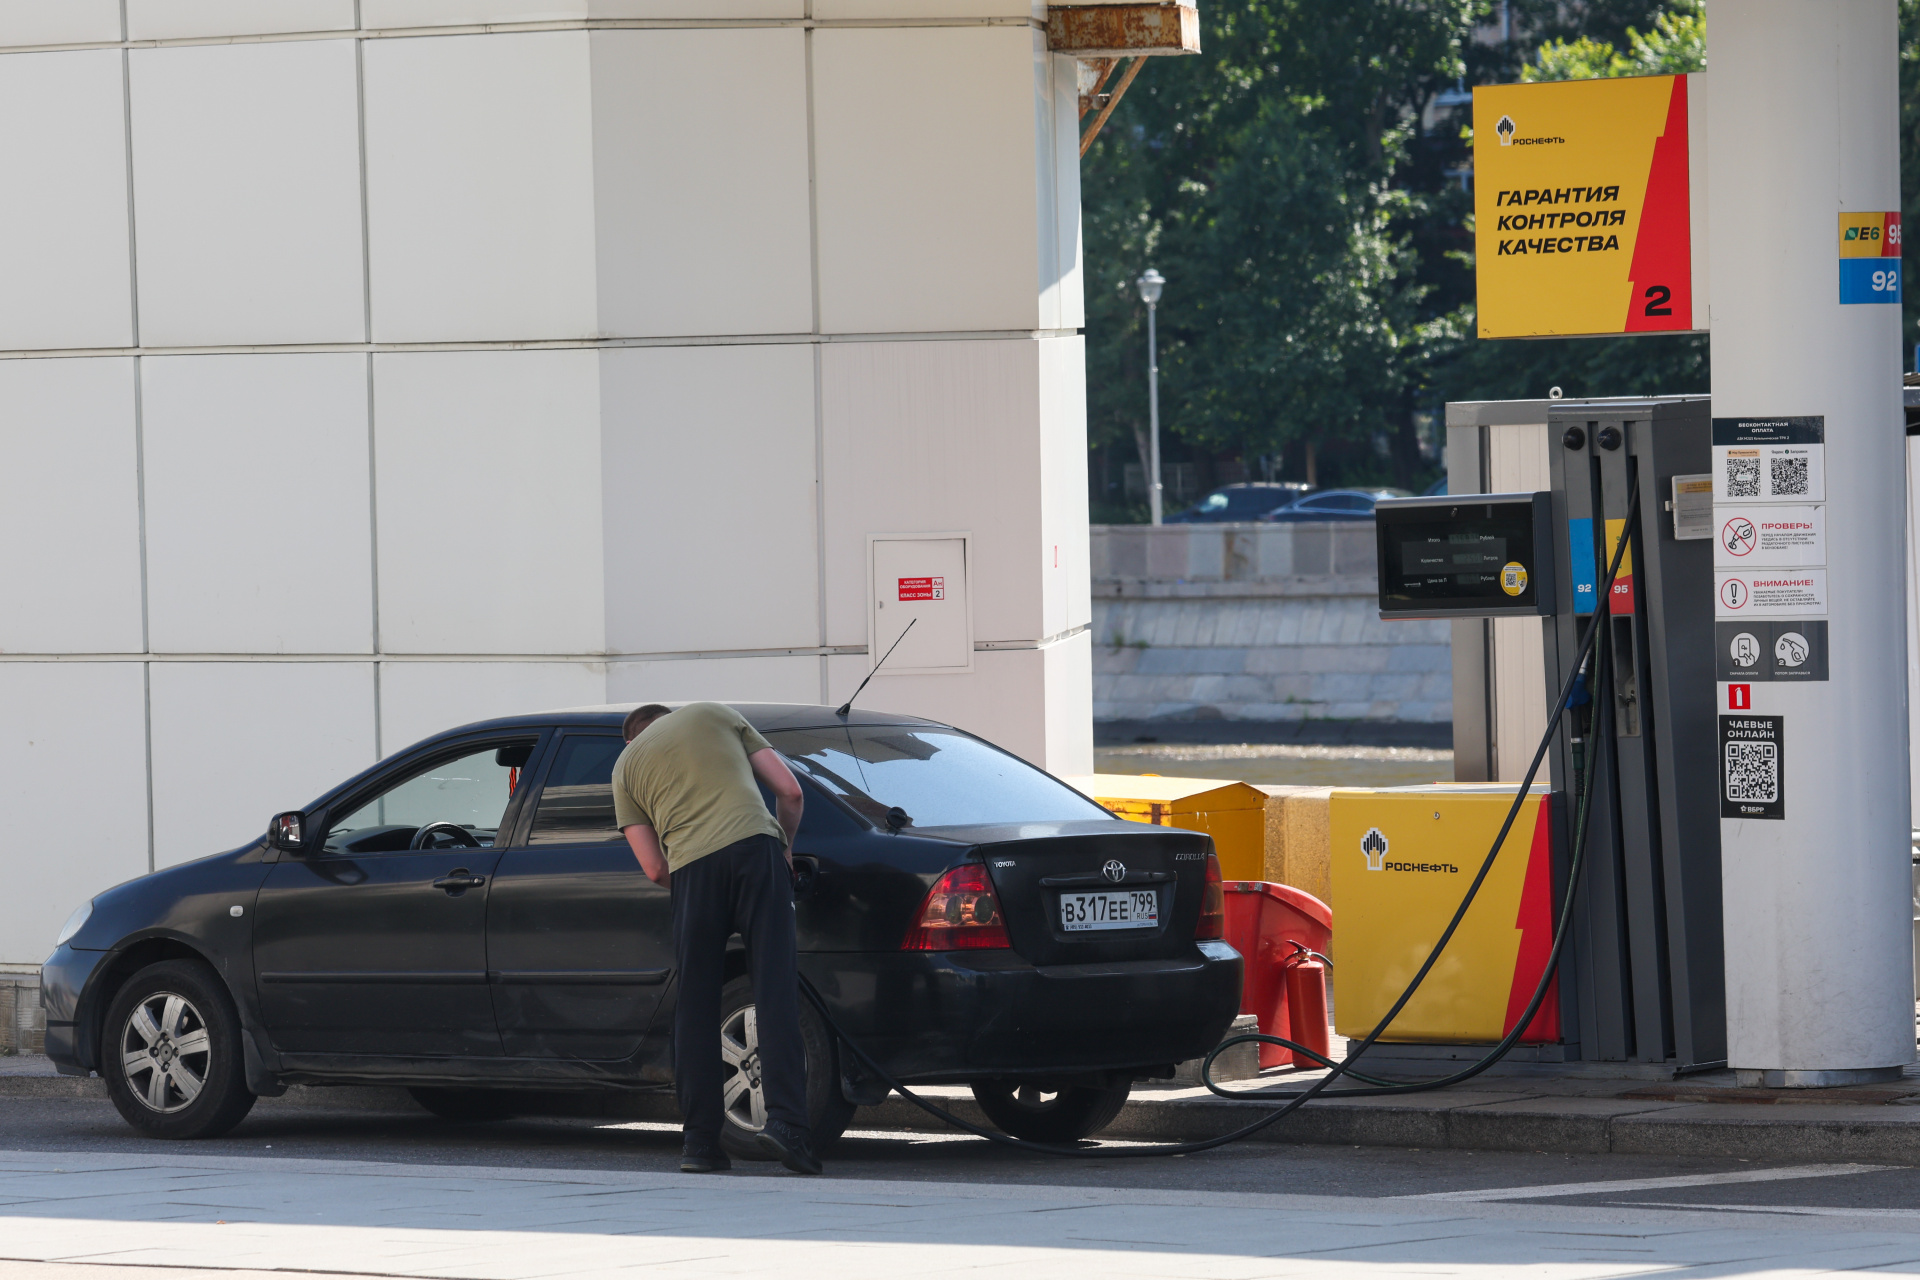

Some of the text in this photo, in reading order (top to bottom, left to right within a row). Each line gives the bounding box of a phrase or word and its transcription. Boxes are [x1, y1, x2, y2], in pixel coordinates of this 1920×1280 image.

[1512, 137, 1565, 145] РОСНЕФТЬ
[1497, 186, 1620, 206] ГАРАНТИЯ
[1497, 210, 1626, 231] КОНТРОЛЯ
[1497, 235, 1620, 256] КАЧЕСТВА
[1872, 271, 1897, 291] 92
[1644, 285, 1672, 317] 2
[1753, 579, 1813, 587] ВНИМАНИЕ!
[1577, 584, 1592, 593] 92
[1614, 585, 1628, 593] 95
[935, 590, 941, 598] 2
[1729, 720, 1773, 729] ЧАЕВЫЕ
[1727, 729, 1775, 738] ОНЛАЙН
[1175, 852, 1205, 860] COROLLA
[1385, 862, 1458, 873] РОСНЕФТЬ
[1131, 893, 1153, 912] 799
